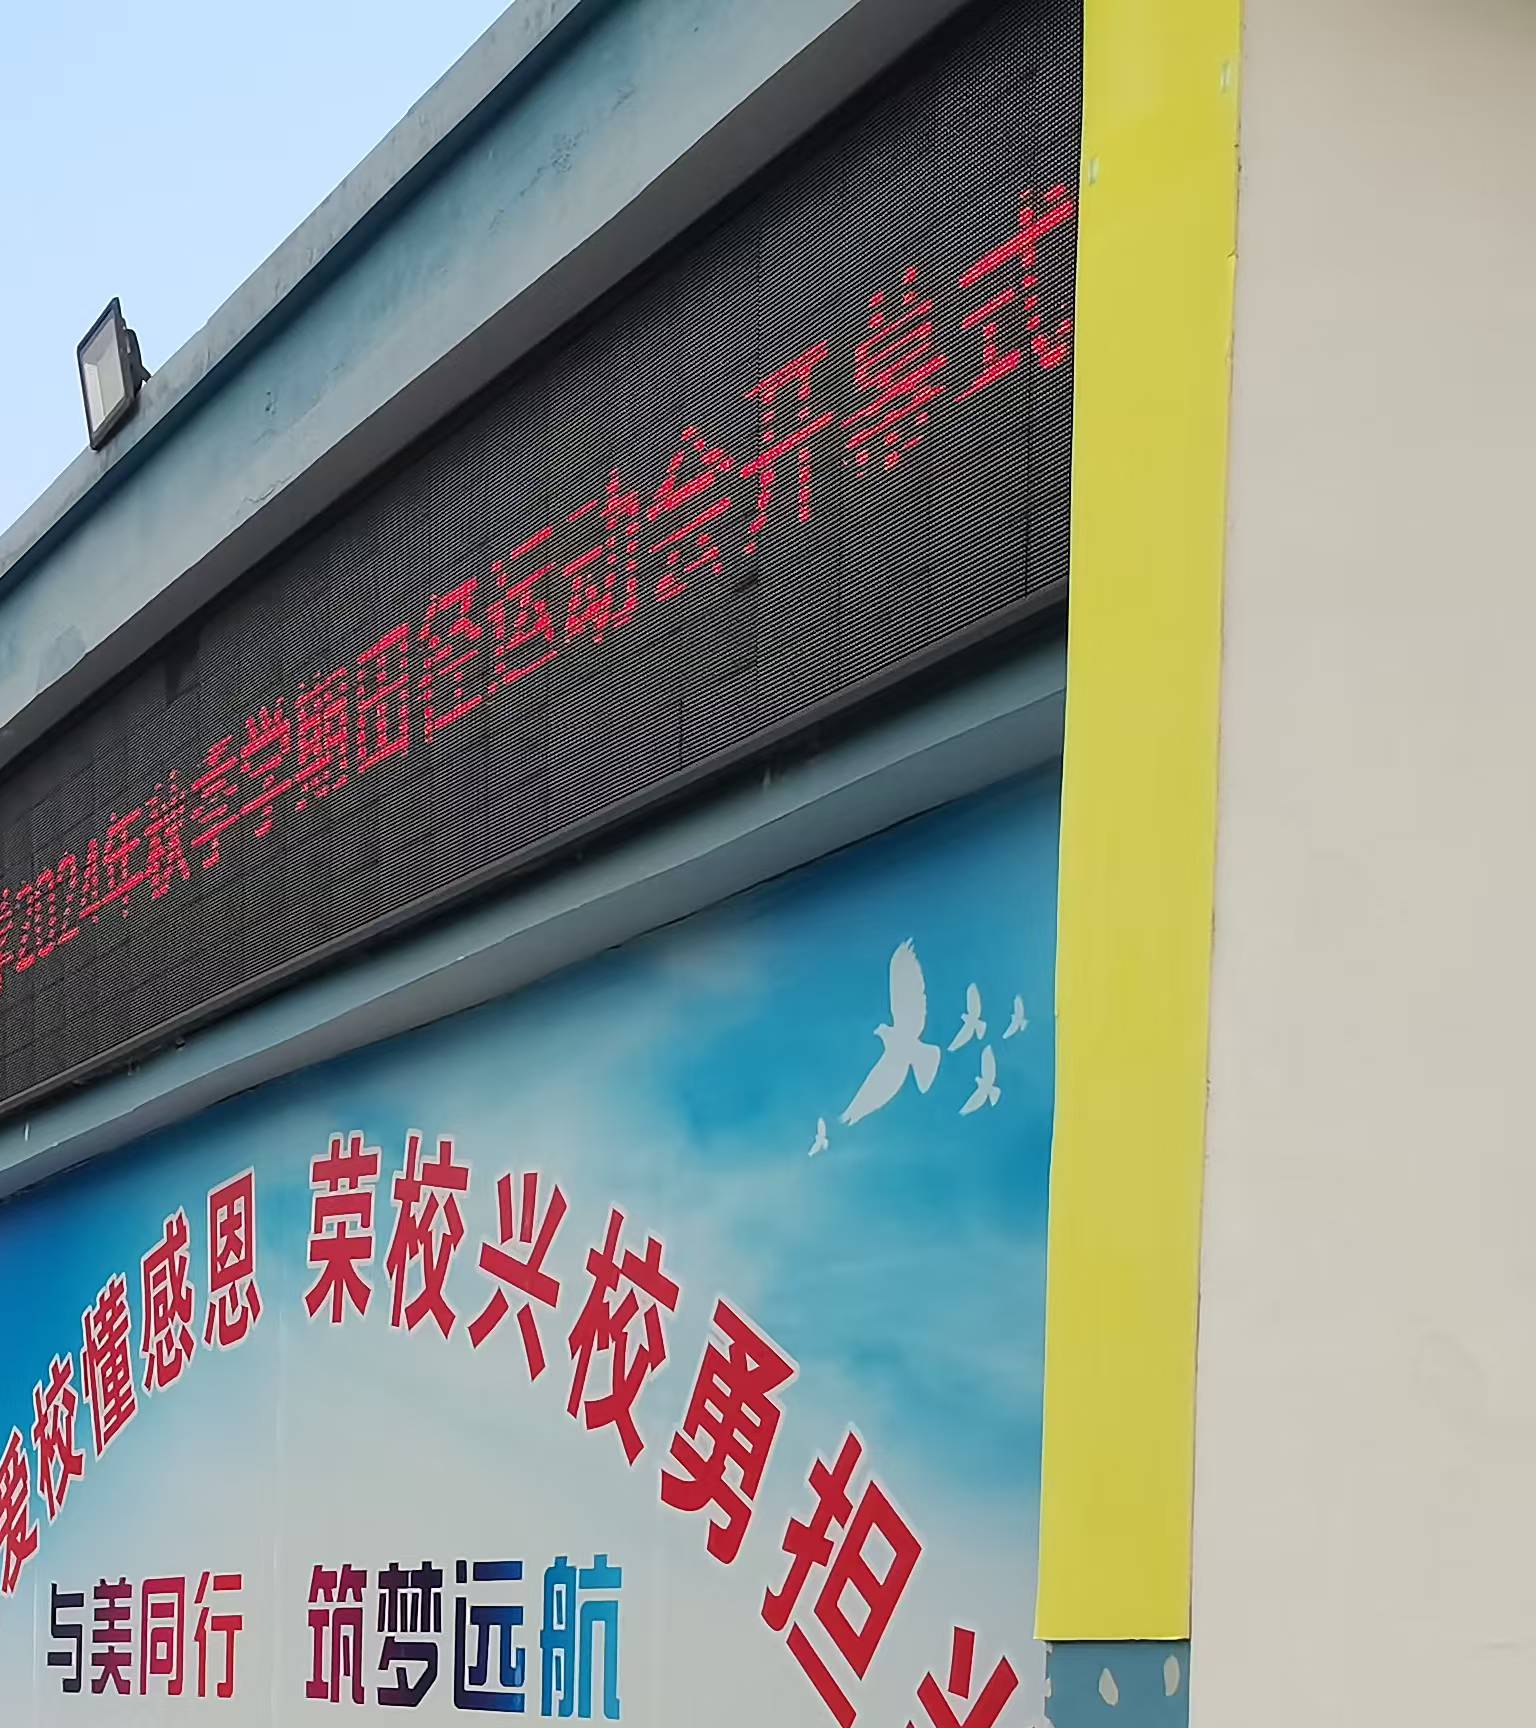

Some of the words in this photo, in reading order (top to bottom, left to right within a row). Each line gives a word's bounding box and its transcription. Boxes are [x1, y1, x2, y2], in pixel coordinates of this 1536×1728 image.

[46, 1570, 244, 1700] 与美同行
[304, 1553, 623, 1720] 筑梦远航
